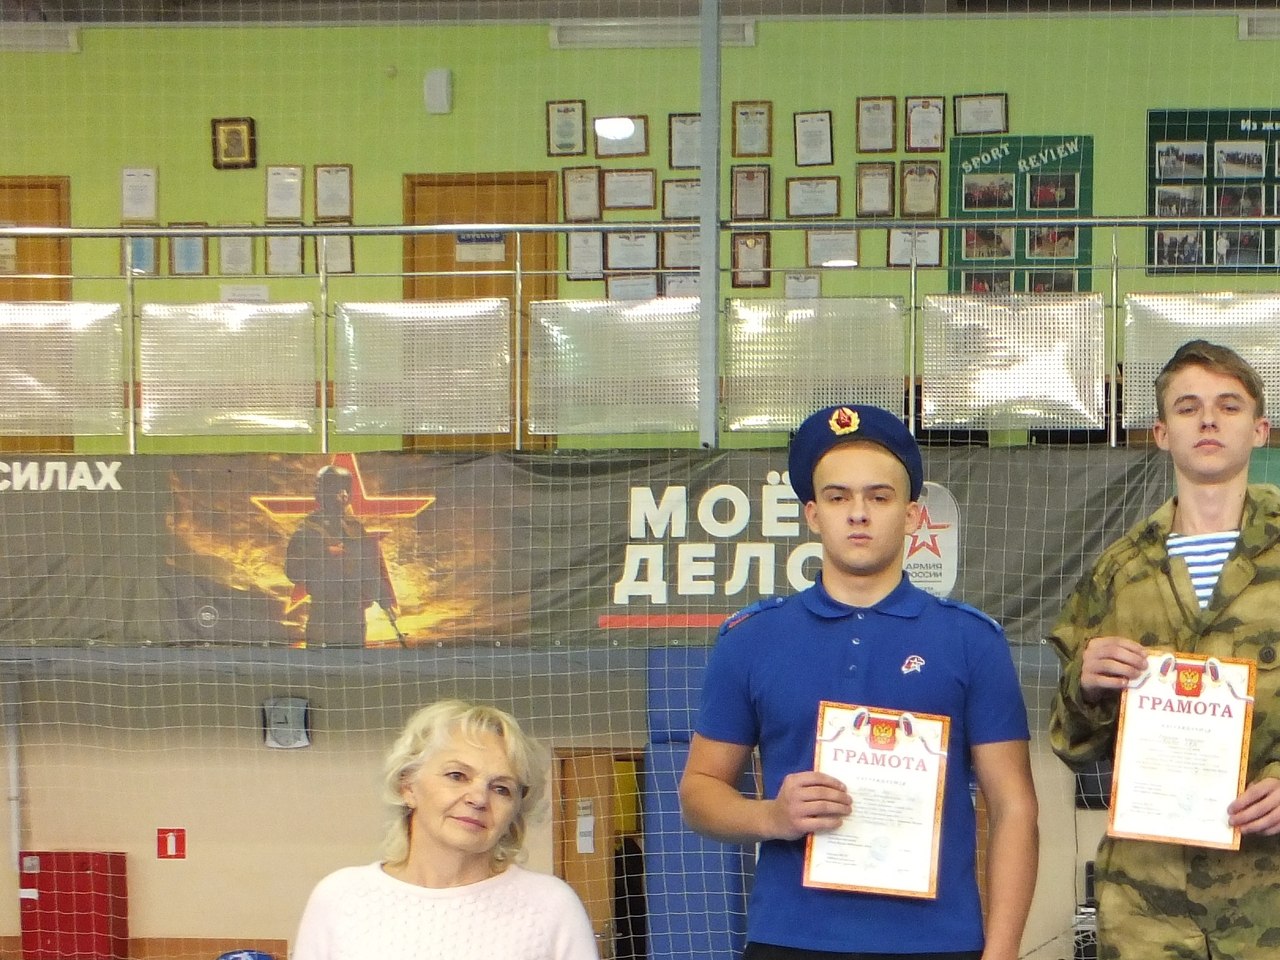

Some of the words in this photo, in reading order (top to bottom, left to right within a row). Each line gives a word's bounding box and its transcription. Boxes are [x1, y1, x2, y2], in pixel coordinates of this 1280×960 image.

[1241, 119, 1258, 131] Из
[961, 142, 1010, 173] SPORT
[1017, 136, 1079, 173] REVIEW
[630, 471, 800, 539] МОЁ
[1138, 695, 1234, 718] ГРАМОТА
[833, 748, 928, 772] ГРАМОТА
